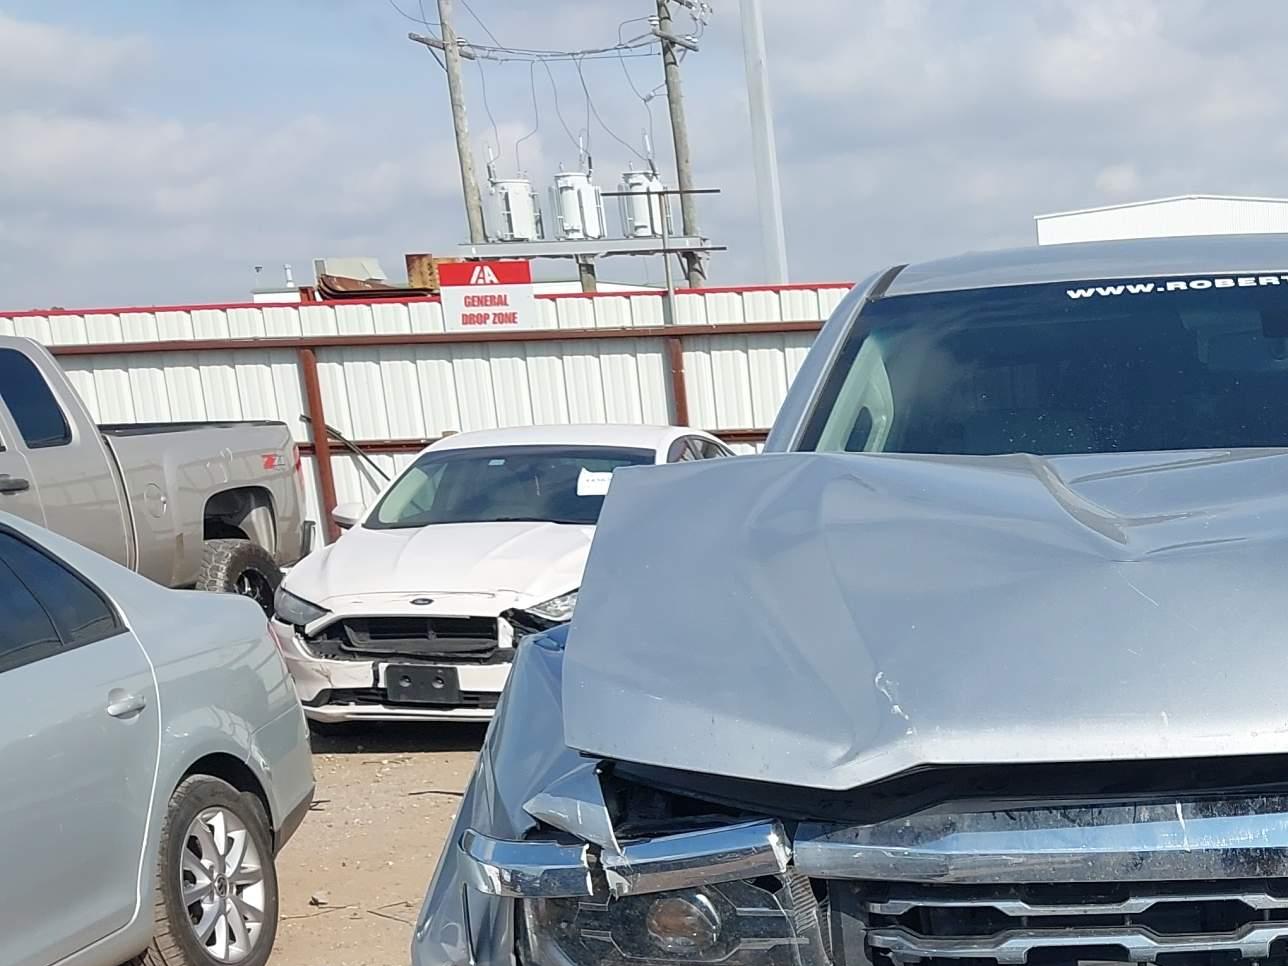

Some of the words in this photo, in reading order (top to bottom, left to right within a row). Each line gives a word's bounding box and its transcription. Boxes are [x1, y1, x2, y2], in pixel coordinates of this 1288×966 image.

[463, 294, 509, 308] GENERAL
[462, 313, 490, 326] DROP
[492, 312, 518, 325] ZONE
